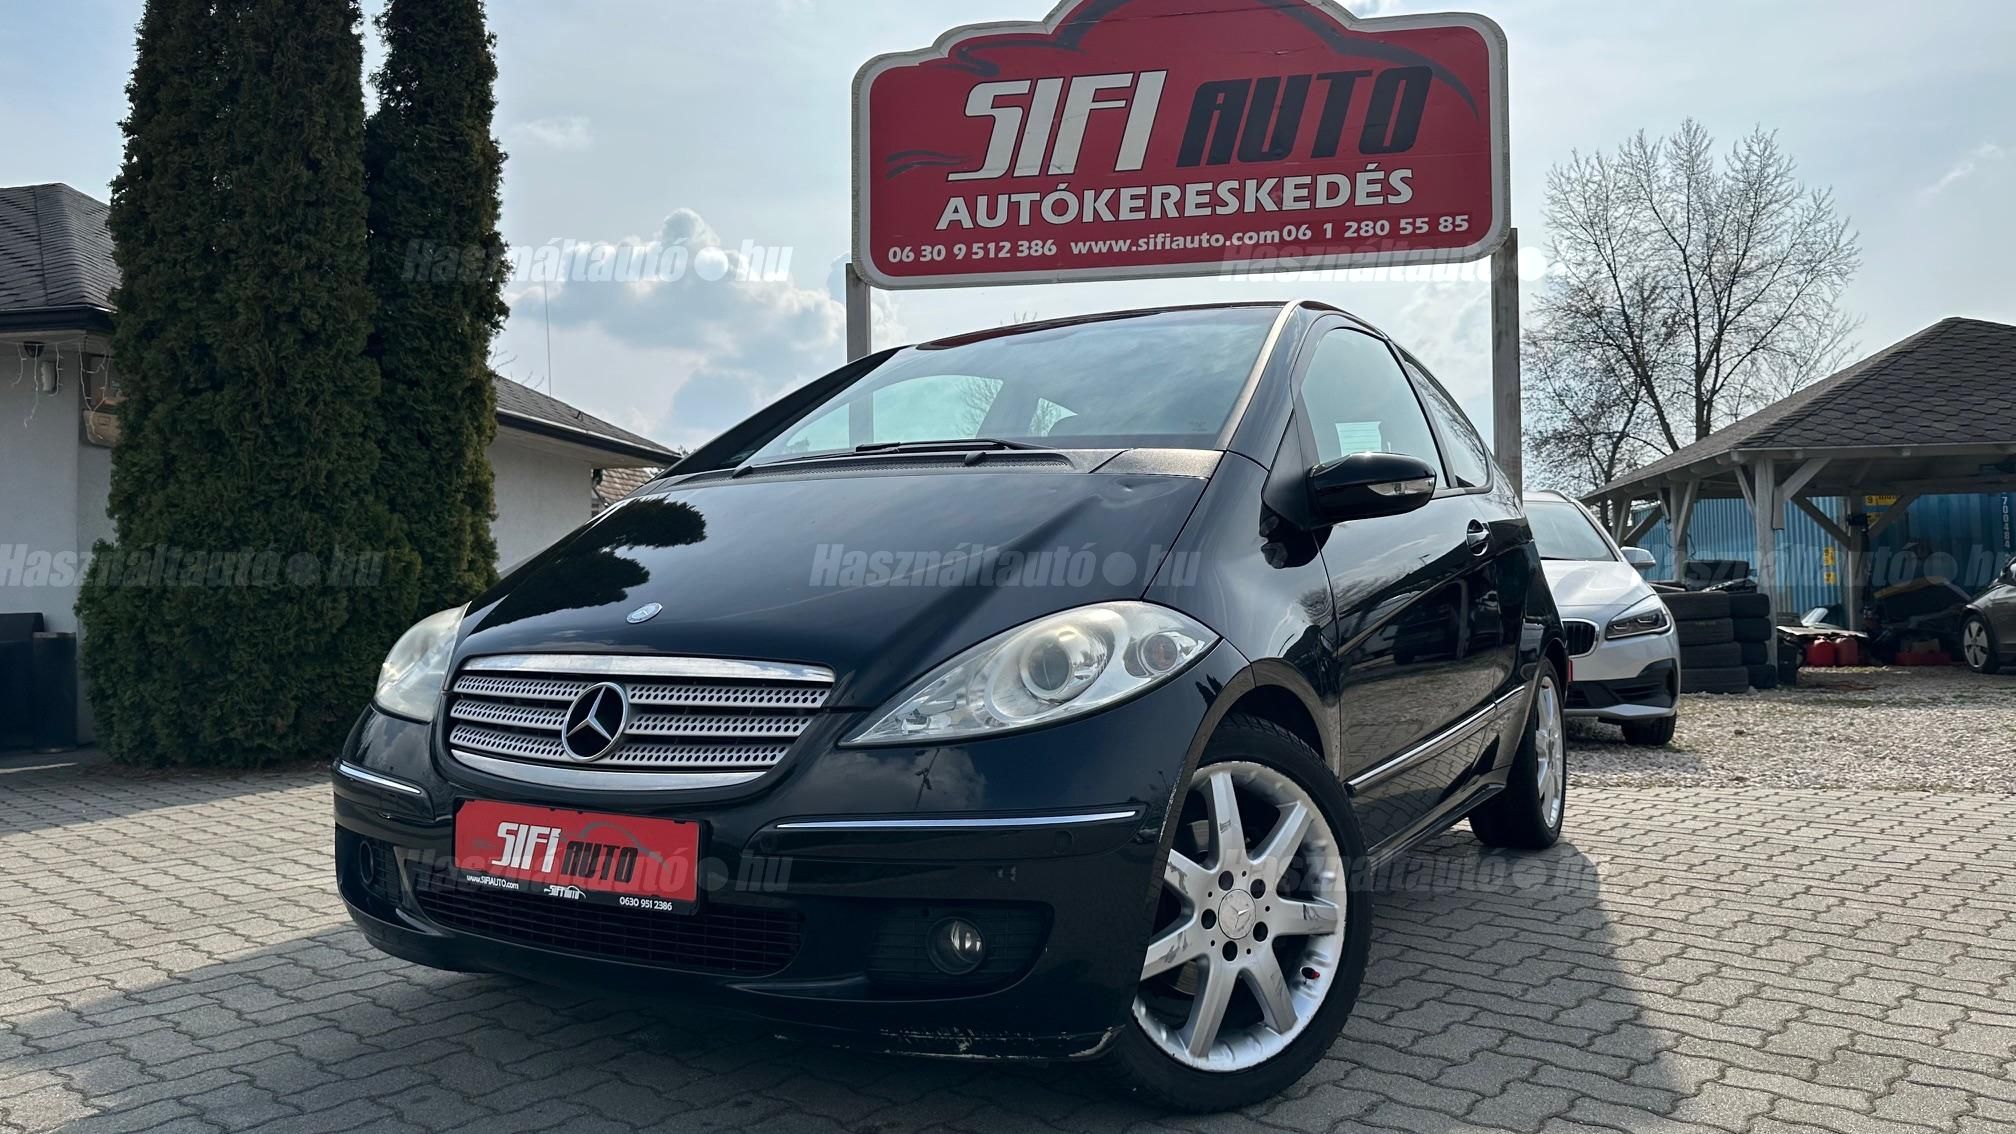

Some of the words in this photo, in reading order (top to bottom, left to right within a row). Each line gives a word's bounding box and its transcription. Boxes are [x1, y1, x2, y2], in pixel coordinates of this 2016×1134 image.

[946, 69, 1168, 182] SIFI
[1176, 66, 1433, 168] AUTO
[935, 162, 1414, 231] AUTÓKERESKEDÉS
[1070, 229, 1280, 254] www.sifiauto.com
[1282, 224, 1312, 242] 06
[1323, 223, 1333, 239] 1
[1344, 219, 1390, 238] 280
[1400, 217, 1429, 234] 55
[1438, 215, 1469, 232] 85
[887, 246, 915, 263] 06
[919, 245, 946, 262] 30
[1016, 239, 1057, 257] 386
[491, 822, 562, 873] SIFI
[560, 840, 638, 884] AUTO
[619, 896, 639, 907] 0630
[640, 899, 653, 908] 951
[654, 901, 672, 911] 2386
